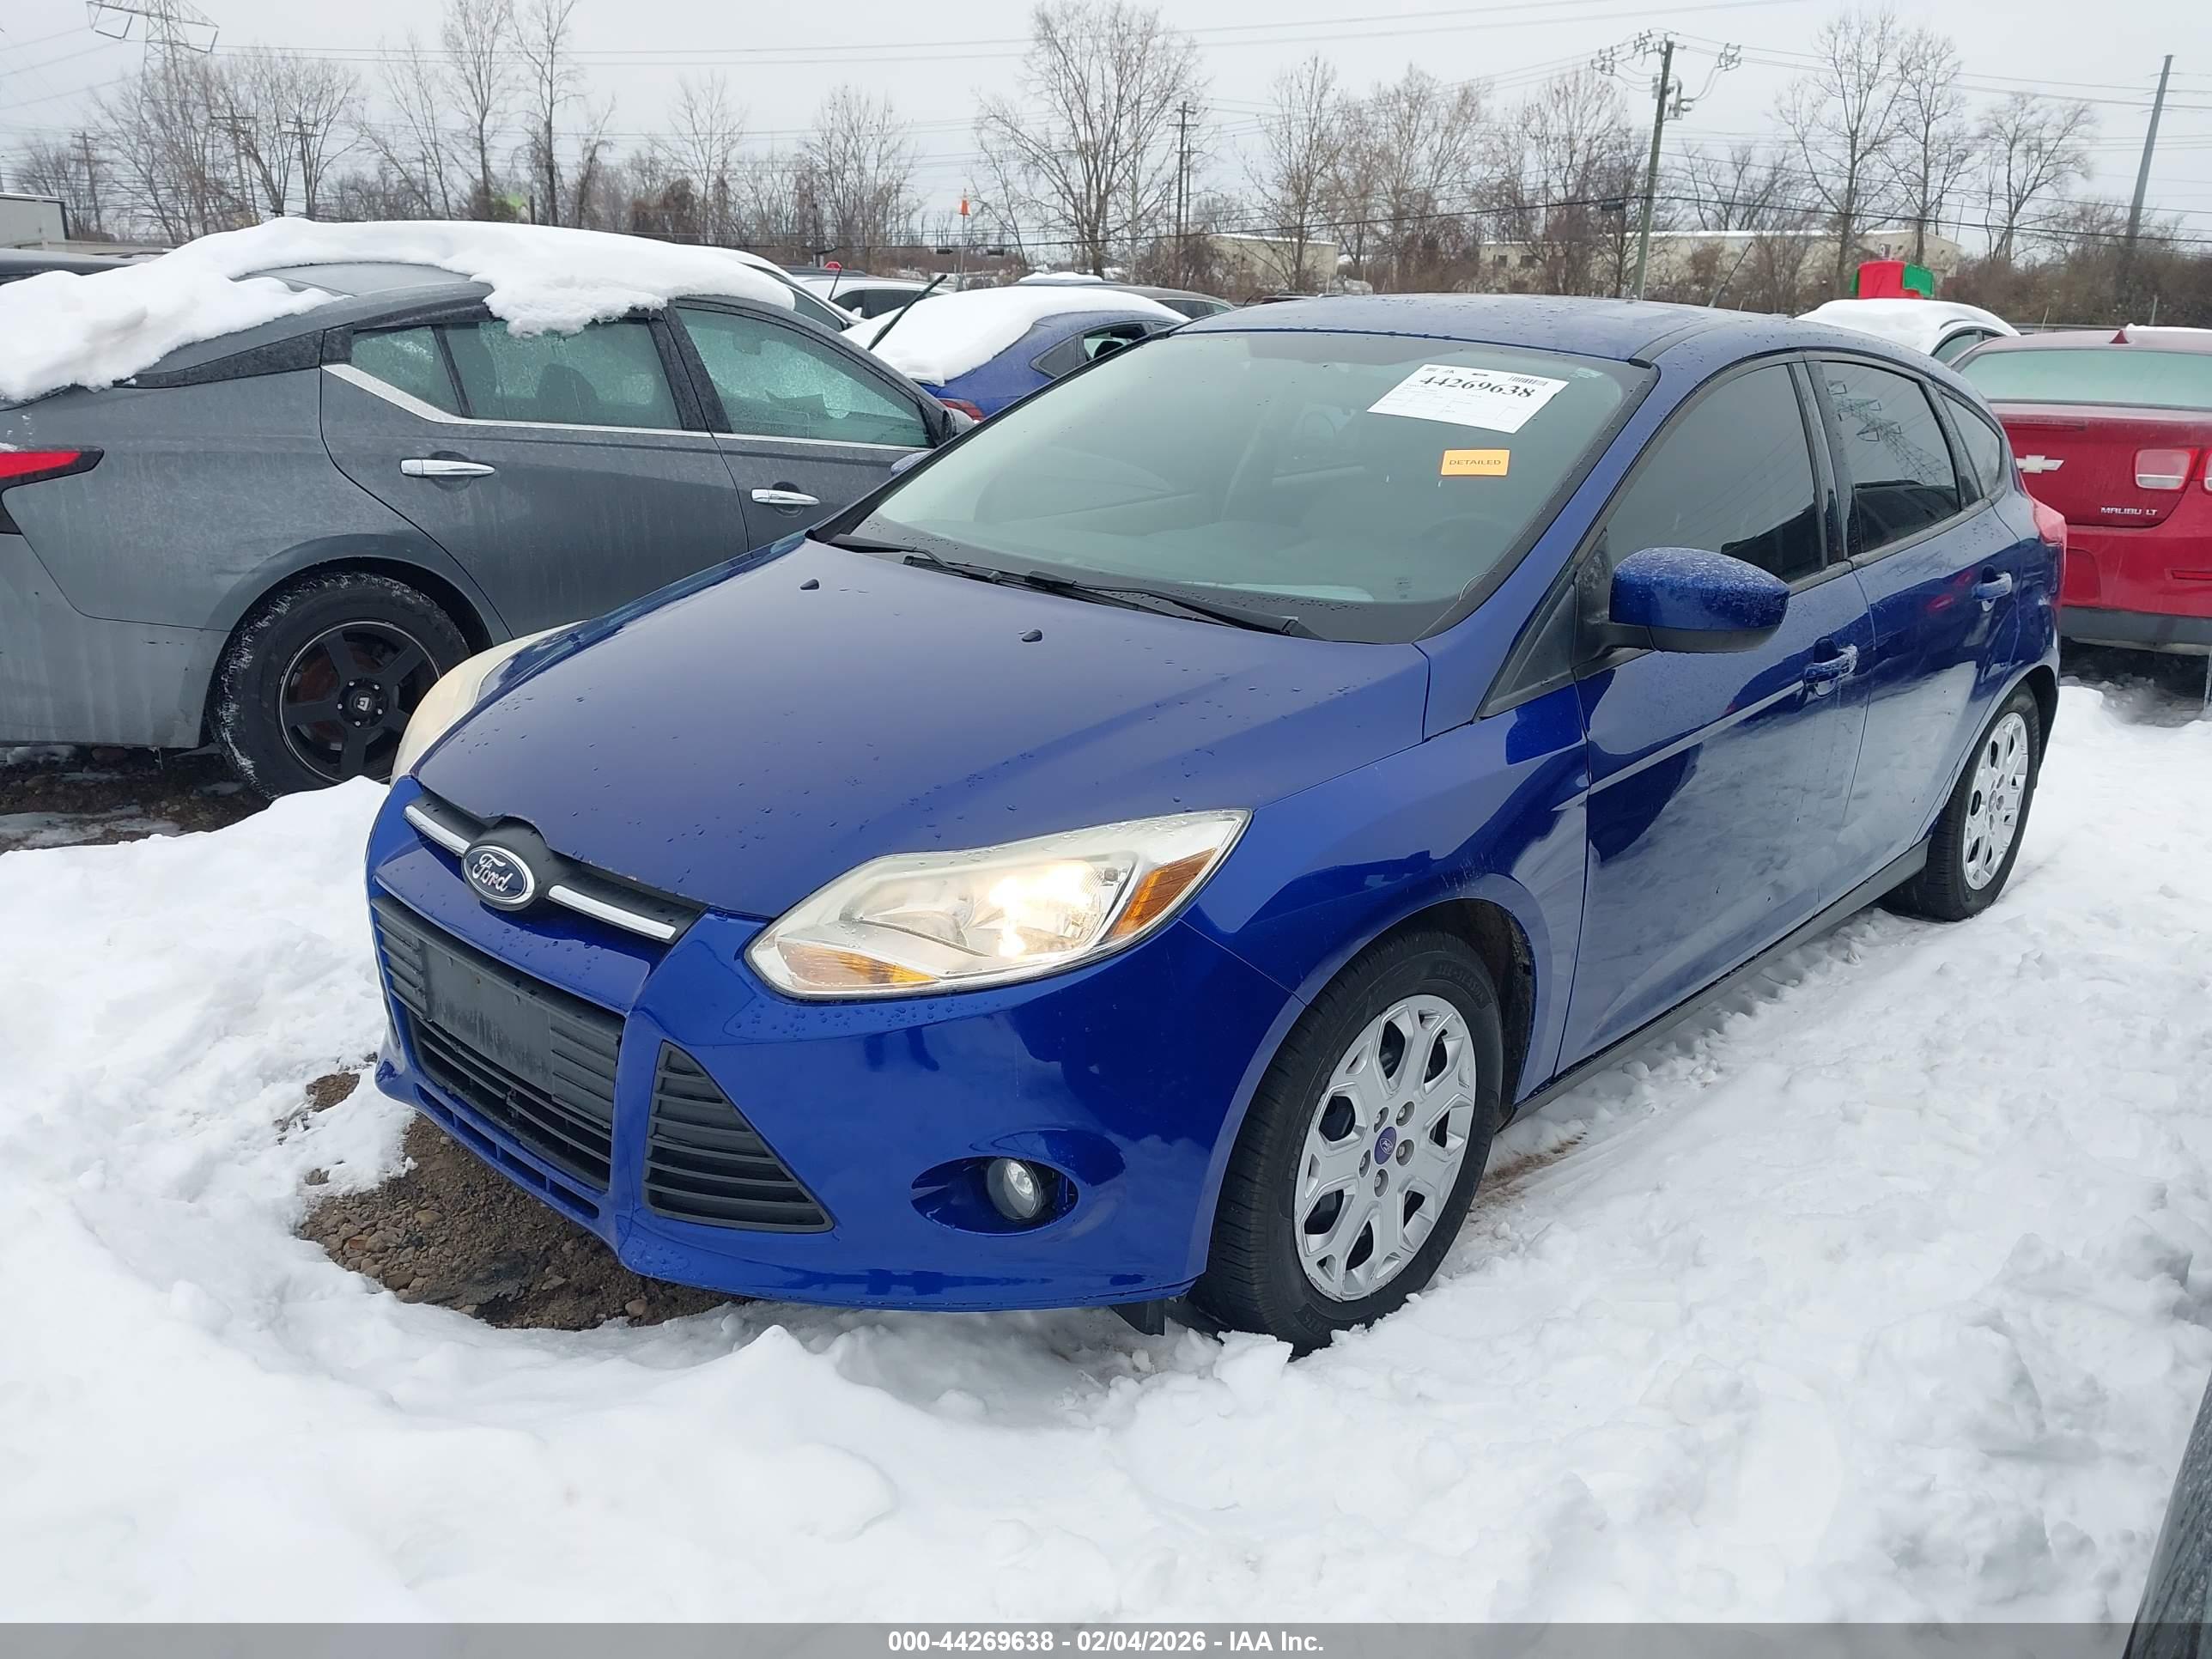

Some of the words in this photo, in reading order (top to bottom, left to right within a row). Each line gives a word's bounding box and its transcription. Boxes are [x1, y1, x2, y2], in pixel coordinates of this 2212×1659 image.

[1419, 375, 1536, 398] 44269638
[2100, 507, 2142, 515] MALIBU
[472, 853, 514, 892] Ford
